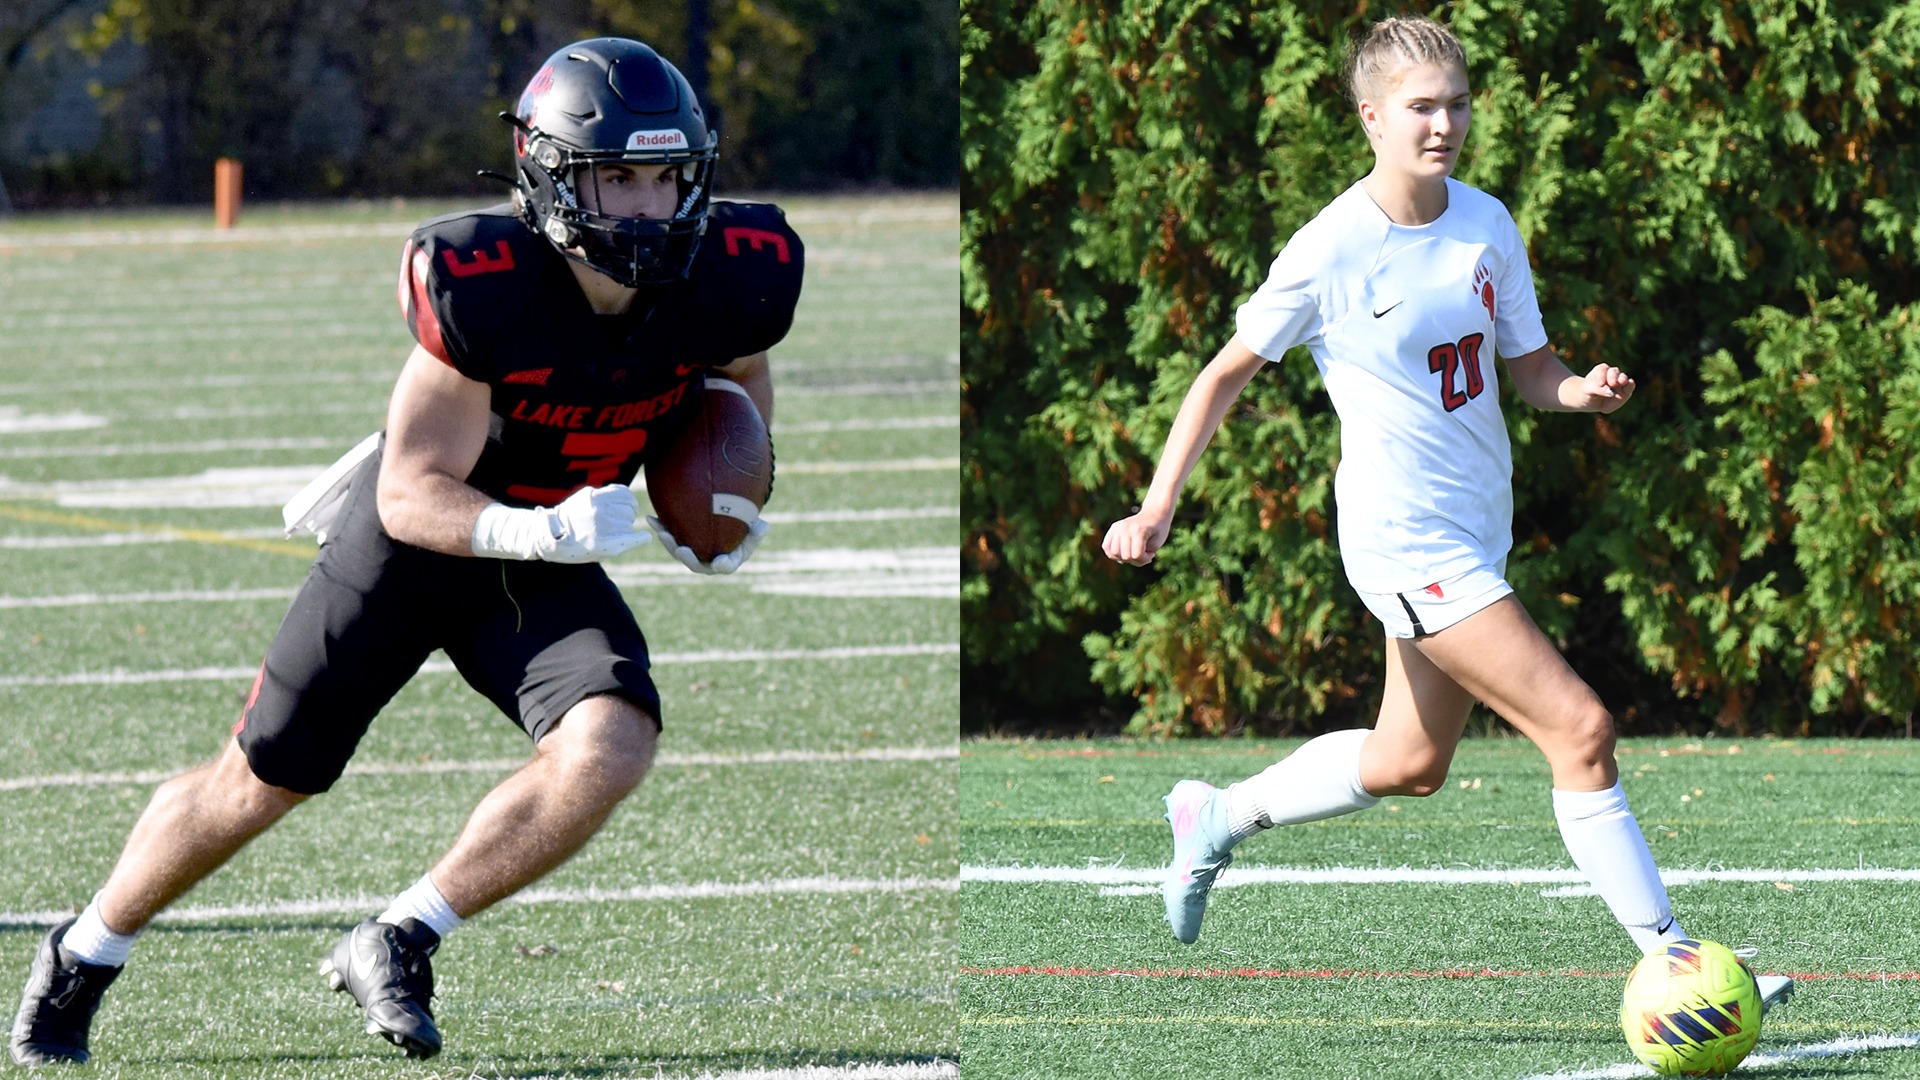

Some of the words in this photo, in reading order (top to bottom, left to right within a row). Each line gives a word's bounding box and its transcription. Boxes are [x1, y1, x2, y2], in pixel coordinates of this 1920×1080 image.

[636, 132, 682, 147] Riddell
[675, 184, 703, 220] Riddell
[441, 239, 515, 279] 3
[724, 226, 792, 264] 3
[1428, 332, 1485, 413] 20
[511, 399, 592, 429] LAKE
[594, 381, 689, 429] FOREST
[506, 428, 648, 506] 3
